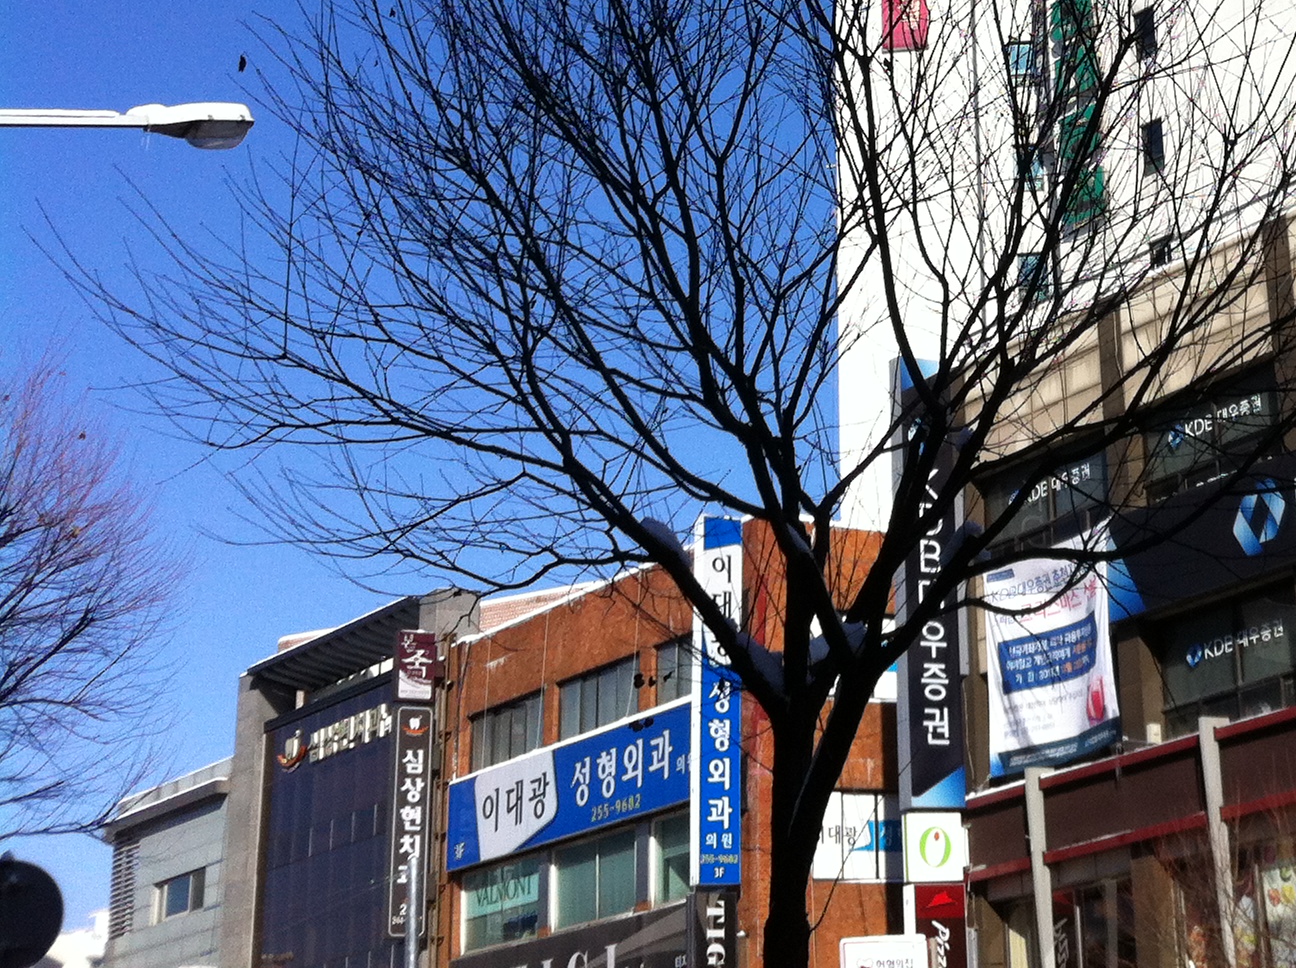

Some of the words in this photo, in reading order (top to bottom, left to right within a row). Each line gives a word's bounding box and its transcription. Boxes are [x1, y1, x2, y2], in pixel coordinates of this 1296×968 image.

[482, 772, 549, 832] 이대광
[571, 730, 673, 807] 성형외과
[708, 681, 733, 829] 성형외과
[591, 794, 641, 822] 255-9682
[705, 833, 733, 849] 의원
